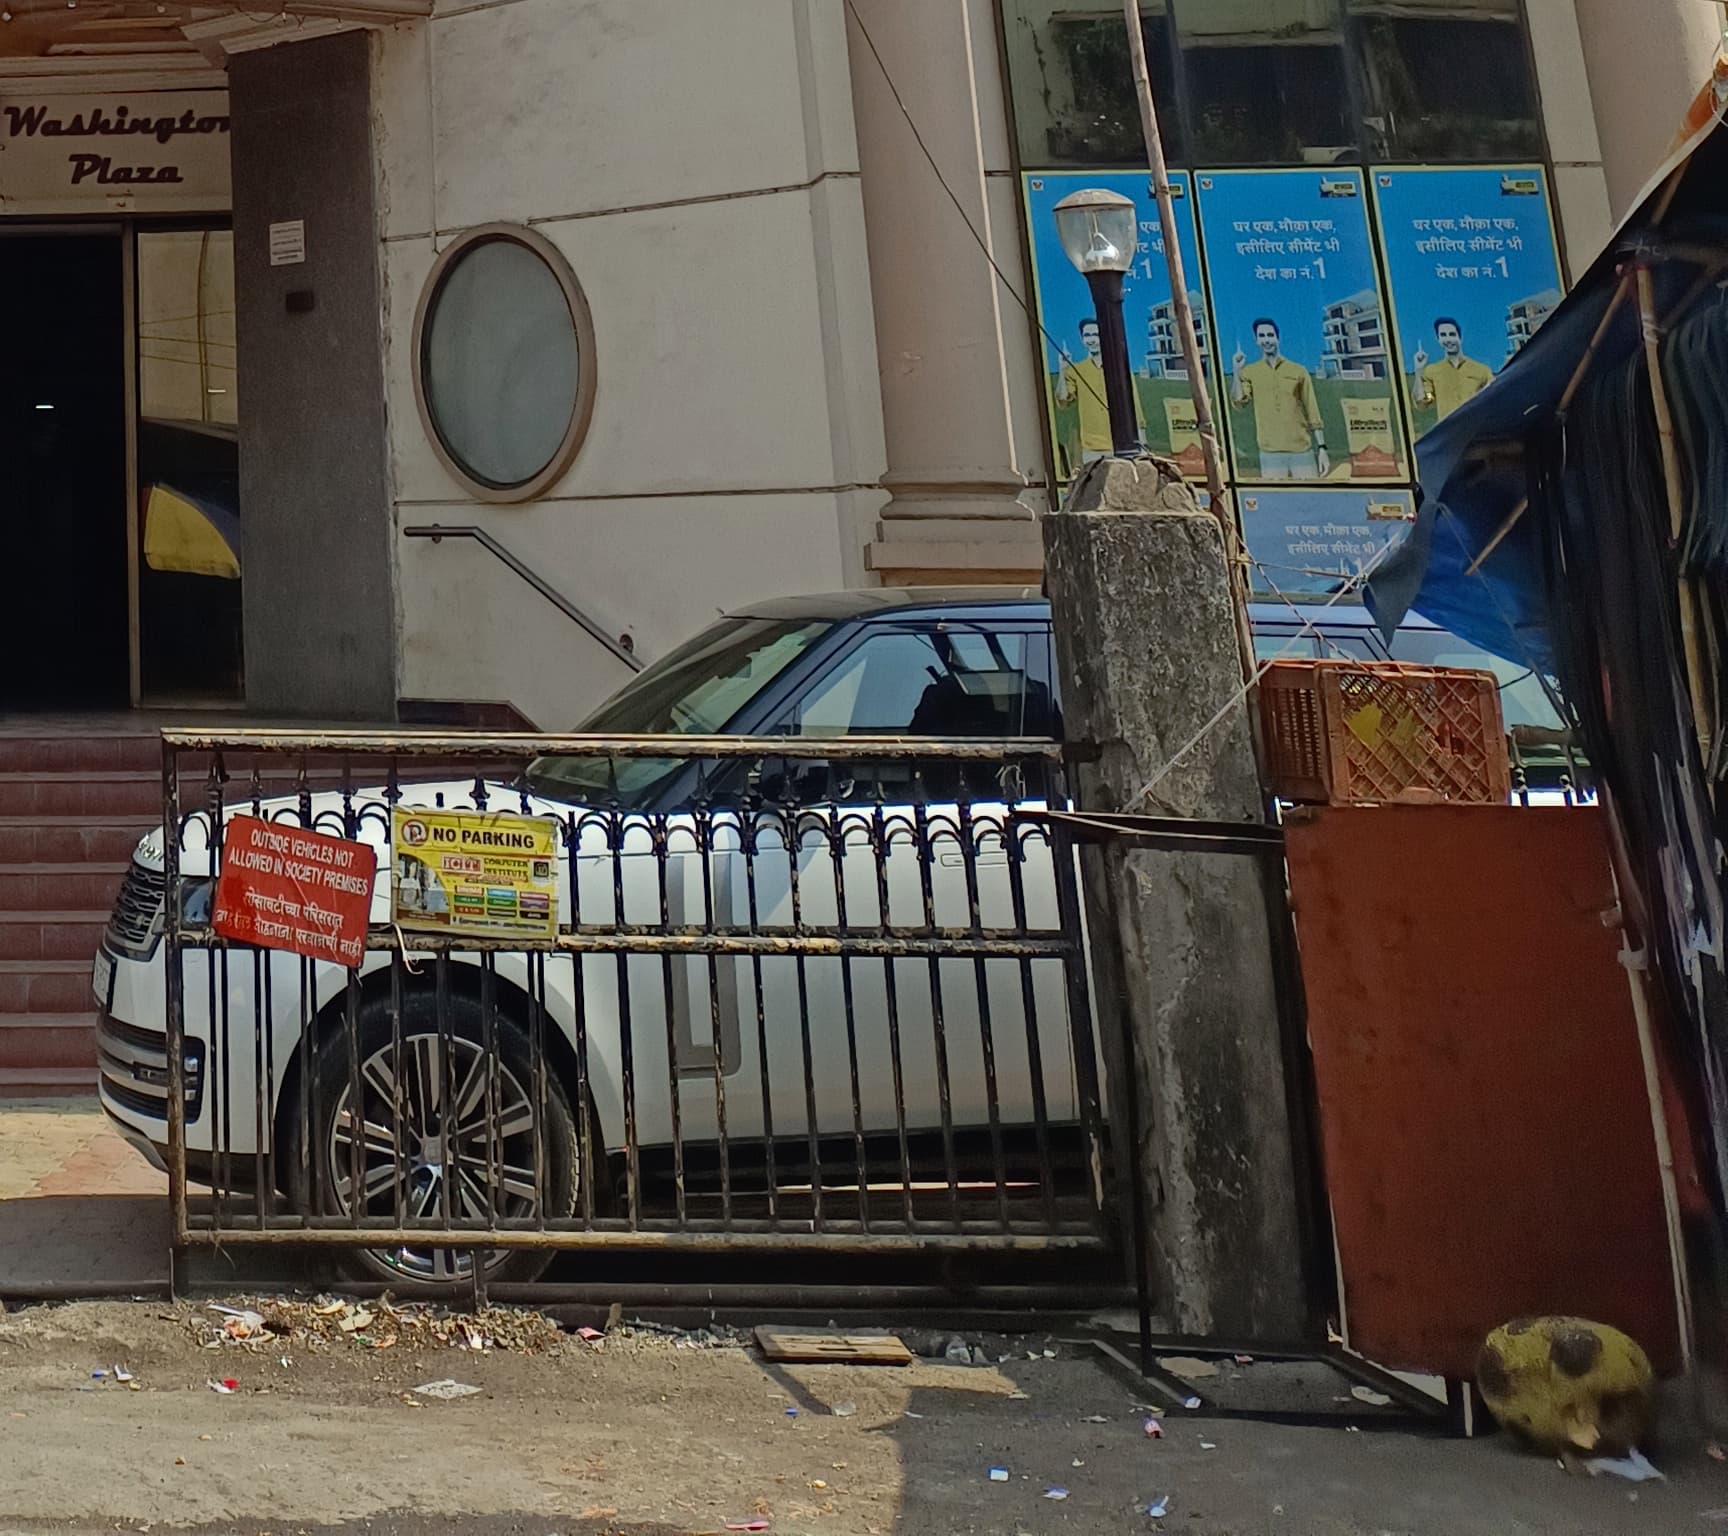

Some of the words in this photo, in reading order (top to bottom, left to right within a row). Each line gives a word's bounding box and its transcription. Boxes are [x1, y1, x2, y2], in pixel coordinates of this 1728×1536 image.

[4, 106, 230, 143] Washington
[69, 153, 184, 185] Plaza
[251, 828, 290, 855] OUTSIDE
[290, 837, 333, 864] VEHICLES
[334, 850, 354, 868] NOT
[433, 828, 457, 843] NO
[461, 830, 535, 849] PARKING
[229, 847, 273, 873] ALLOWED
[273, 859, 284, 875] IN
[284, 860, 324, 885] SOCIETY
[323, 870, 368, 896] PREMISES
